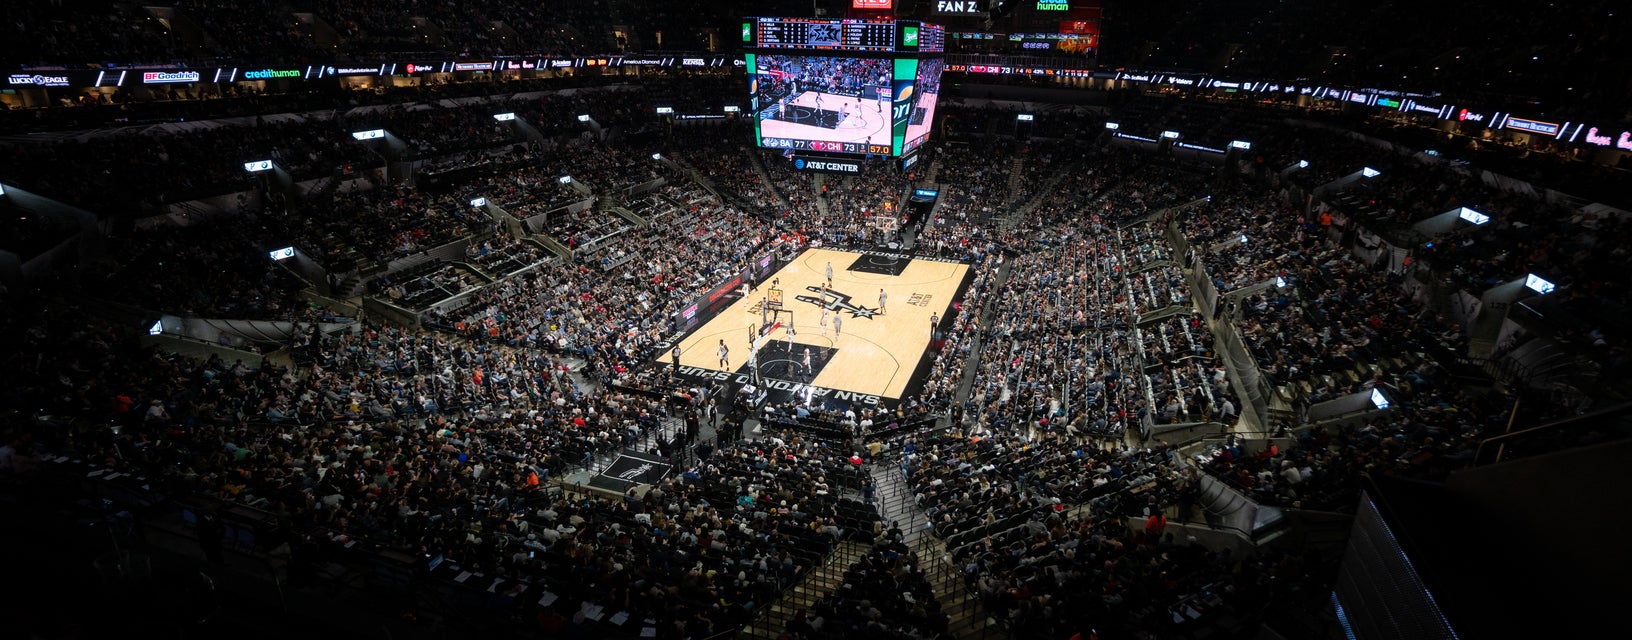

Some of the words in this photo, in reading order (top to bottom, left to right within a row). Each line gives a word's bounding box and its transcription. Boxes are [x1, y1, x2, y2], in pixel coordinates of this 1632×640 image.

[937, 1, 964, 12] FAN
[1037, 2, 1069, 11] human
[245, 69, 300, 79] credithuman
[780, 139, 791, 147] SA
[827, 142, 841, 150] CHI
[844, 144, 855, 152] 73
[870, 146, 890, 154] 57.0
[806, 161, 825, 169] AT&T
[826, 162, 859, 172] CENTER
[833, 390, 881, 405] SAN
